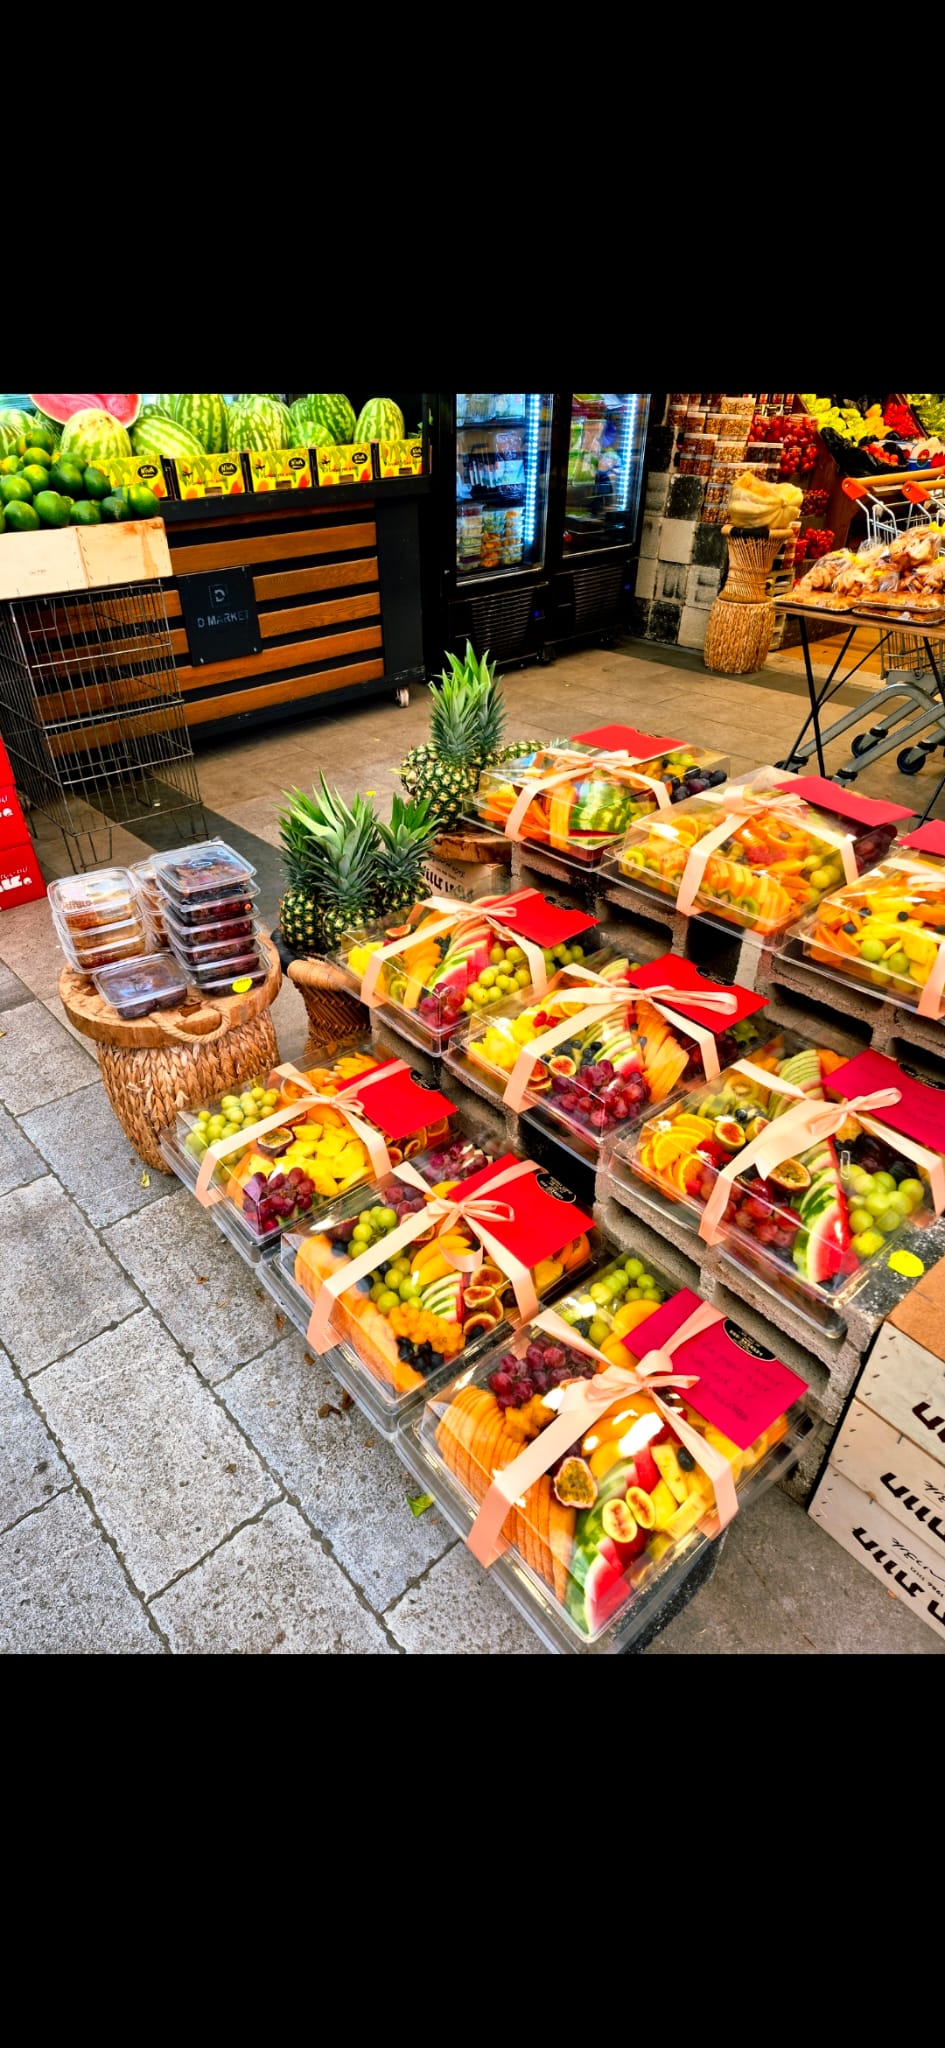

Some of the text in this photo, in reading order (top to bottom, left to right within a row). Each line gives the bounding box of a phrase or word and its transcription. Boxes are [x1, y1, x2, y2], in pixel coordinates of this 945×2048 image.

[197, 609, 249, 628] D MARKET
[851, 1526, 926, 1598] חוות
